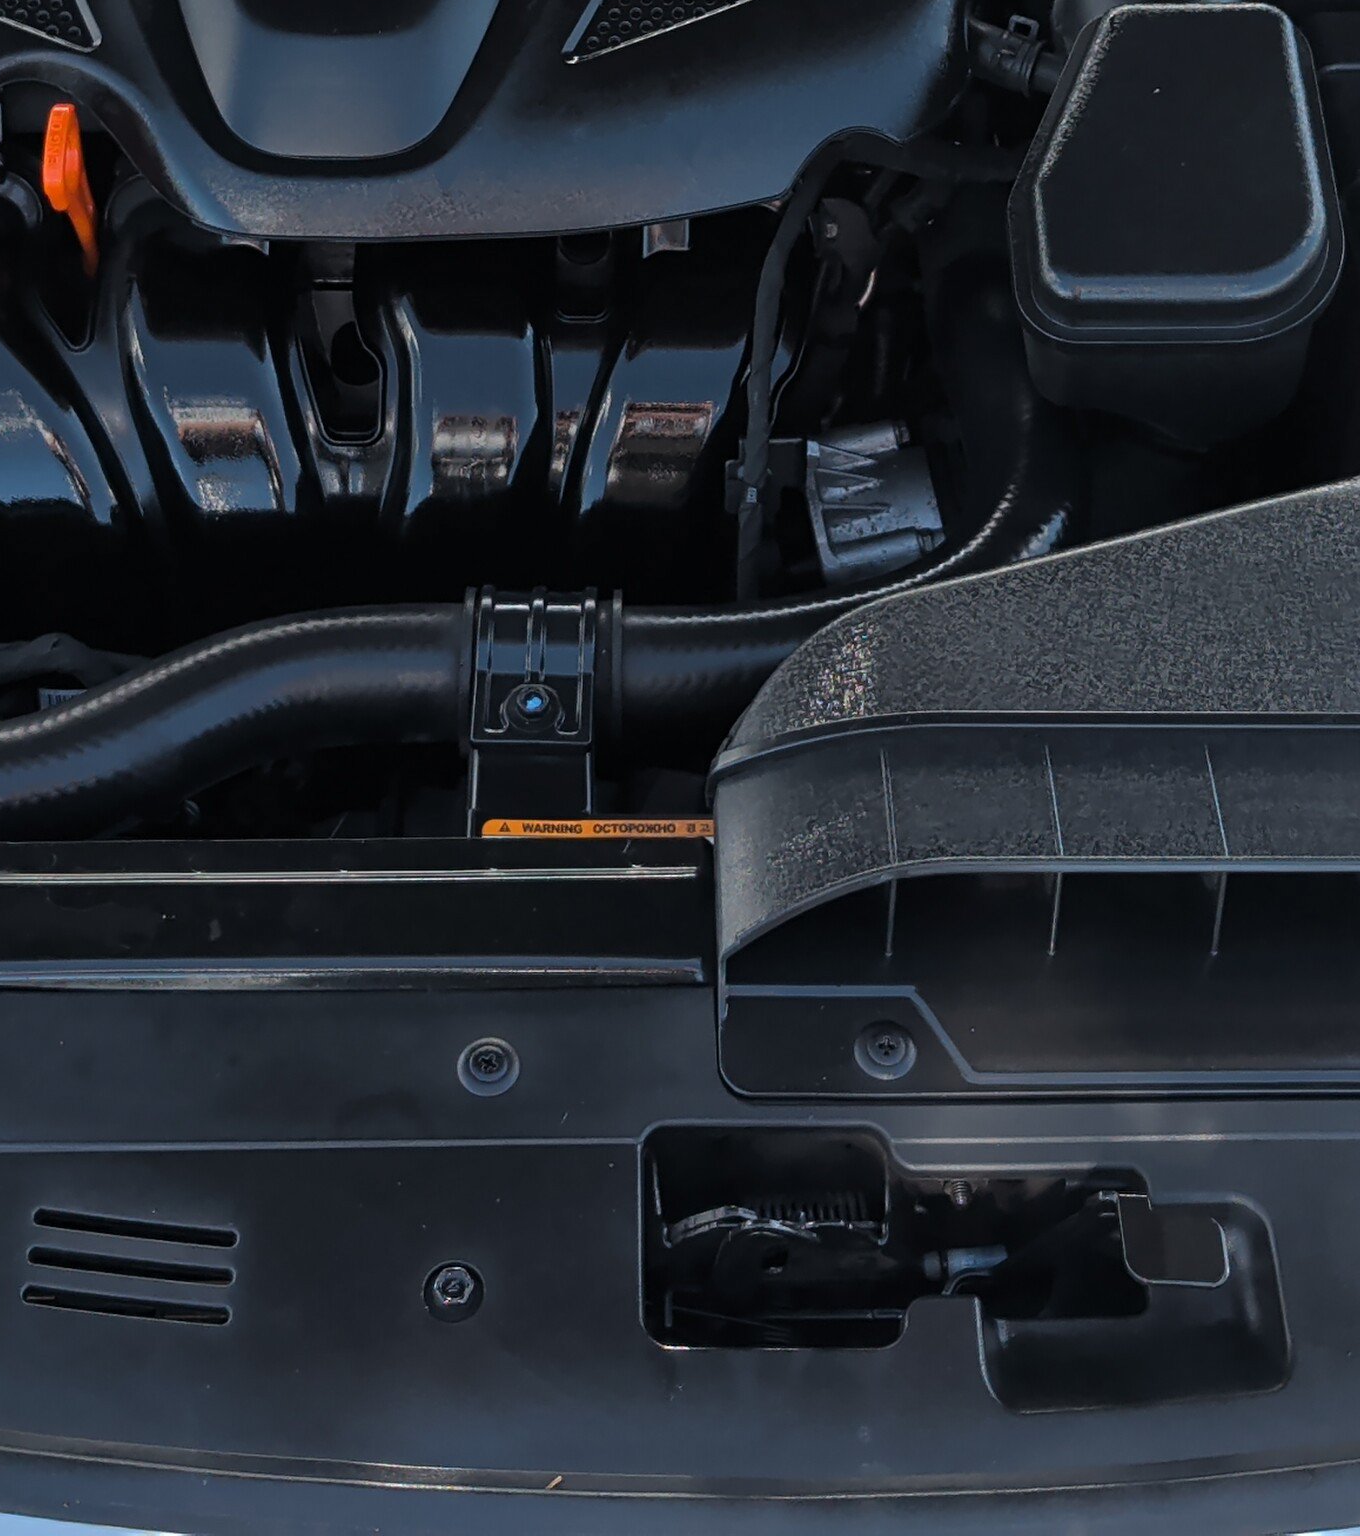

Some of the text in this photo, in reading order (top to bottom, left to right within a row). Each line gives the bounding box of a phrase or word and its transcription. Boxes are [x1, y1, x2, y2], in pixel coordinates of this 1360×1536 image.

[47, 135, 61, 164] ENG
[522, 822, 583, 833] WARNING
[592, 822, 677, 833] ОСТОРОЖНО
